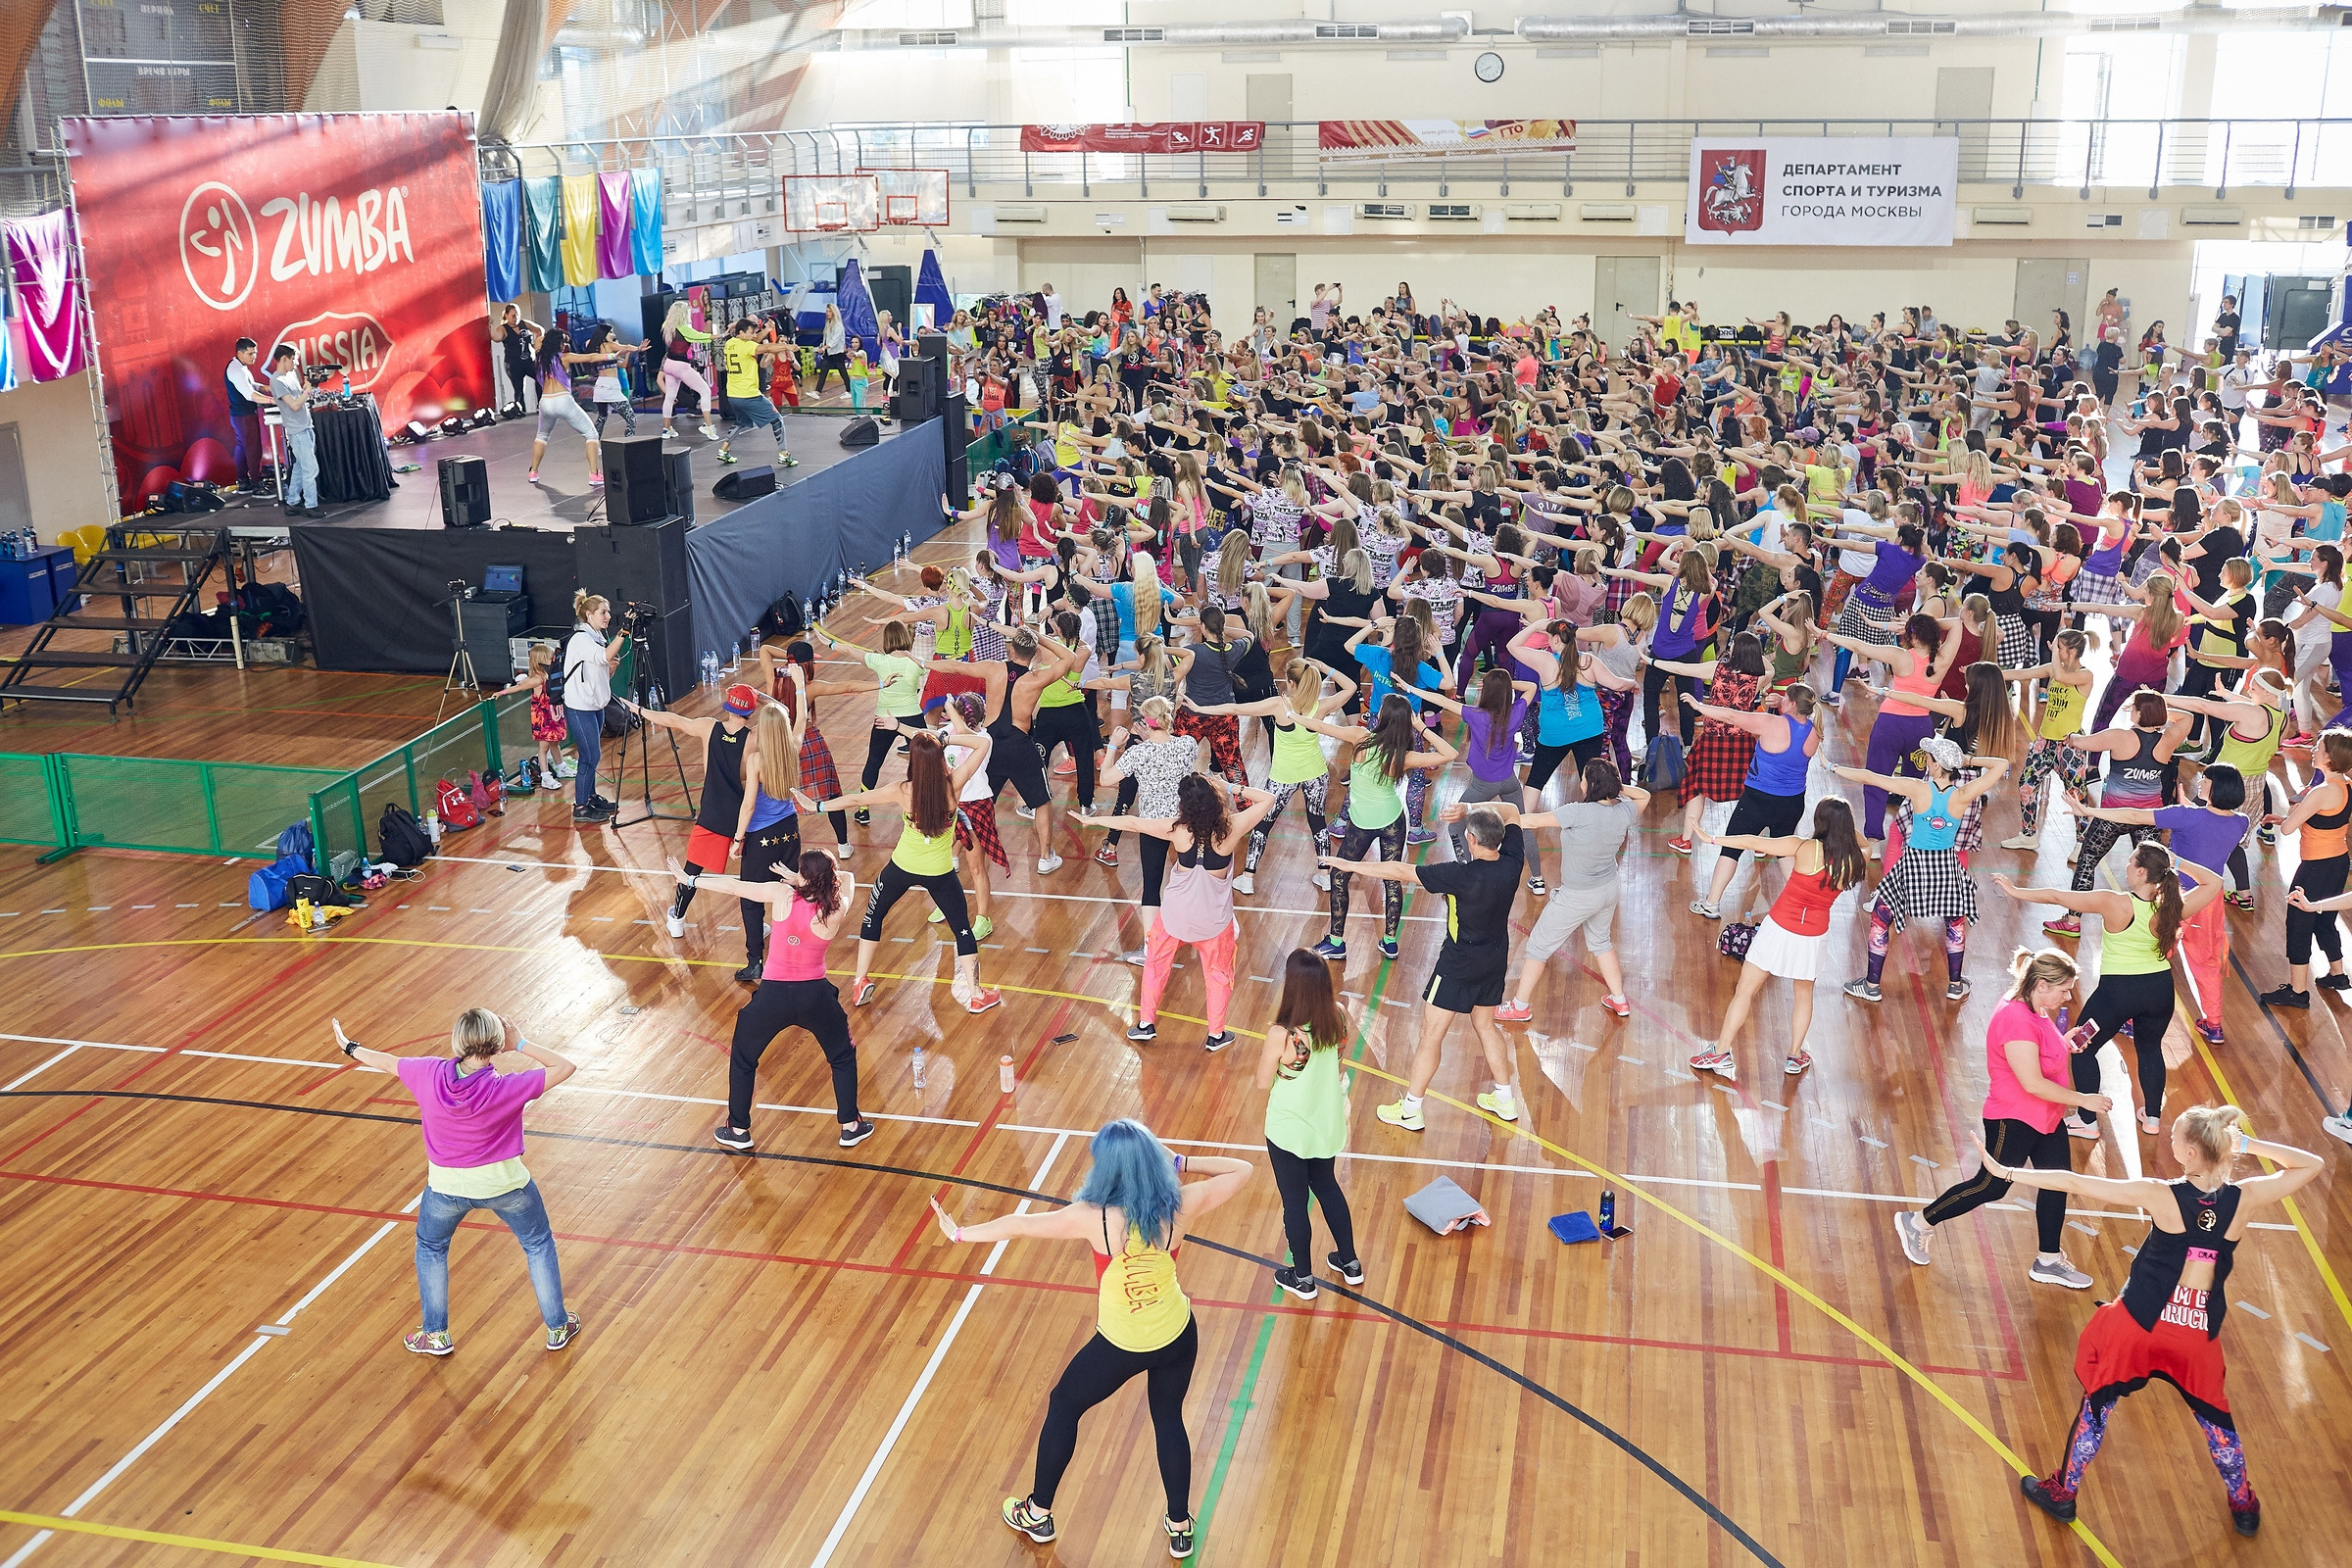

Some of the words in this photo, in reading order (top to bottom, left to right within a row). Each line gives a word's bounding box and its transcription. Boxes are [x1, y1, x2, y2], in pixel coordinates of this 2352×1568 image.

[1499, 124, 1525, 138] ГТО
[1783, 164, 1902, 177] ДЕПАРТАМЕНТ
[1782, 185, 1846, 197] СПОРТА
[1851, 185, 1862, 197] И
[1867, 185, 1942, 197] ТУРИЗМА
[1782, 205, 1846, 219] ГОРОДА
[1851, 206, 1922, 218] МОСКВЫ
[260, 186, 415, 282] ZUMBA
[297, 325, 378, 379] USSIA
[1490, 583, 1516, 594] ZUMBA
[2123, 767, 2162, 781] ZUMBA
